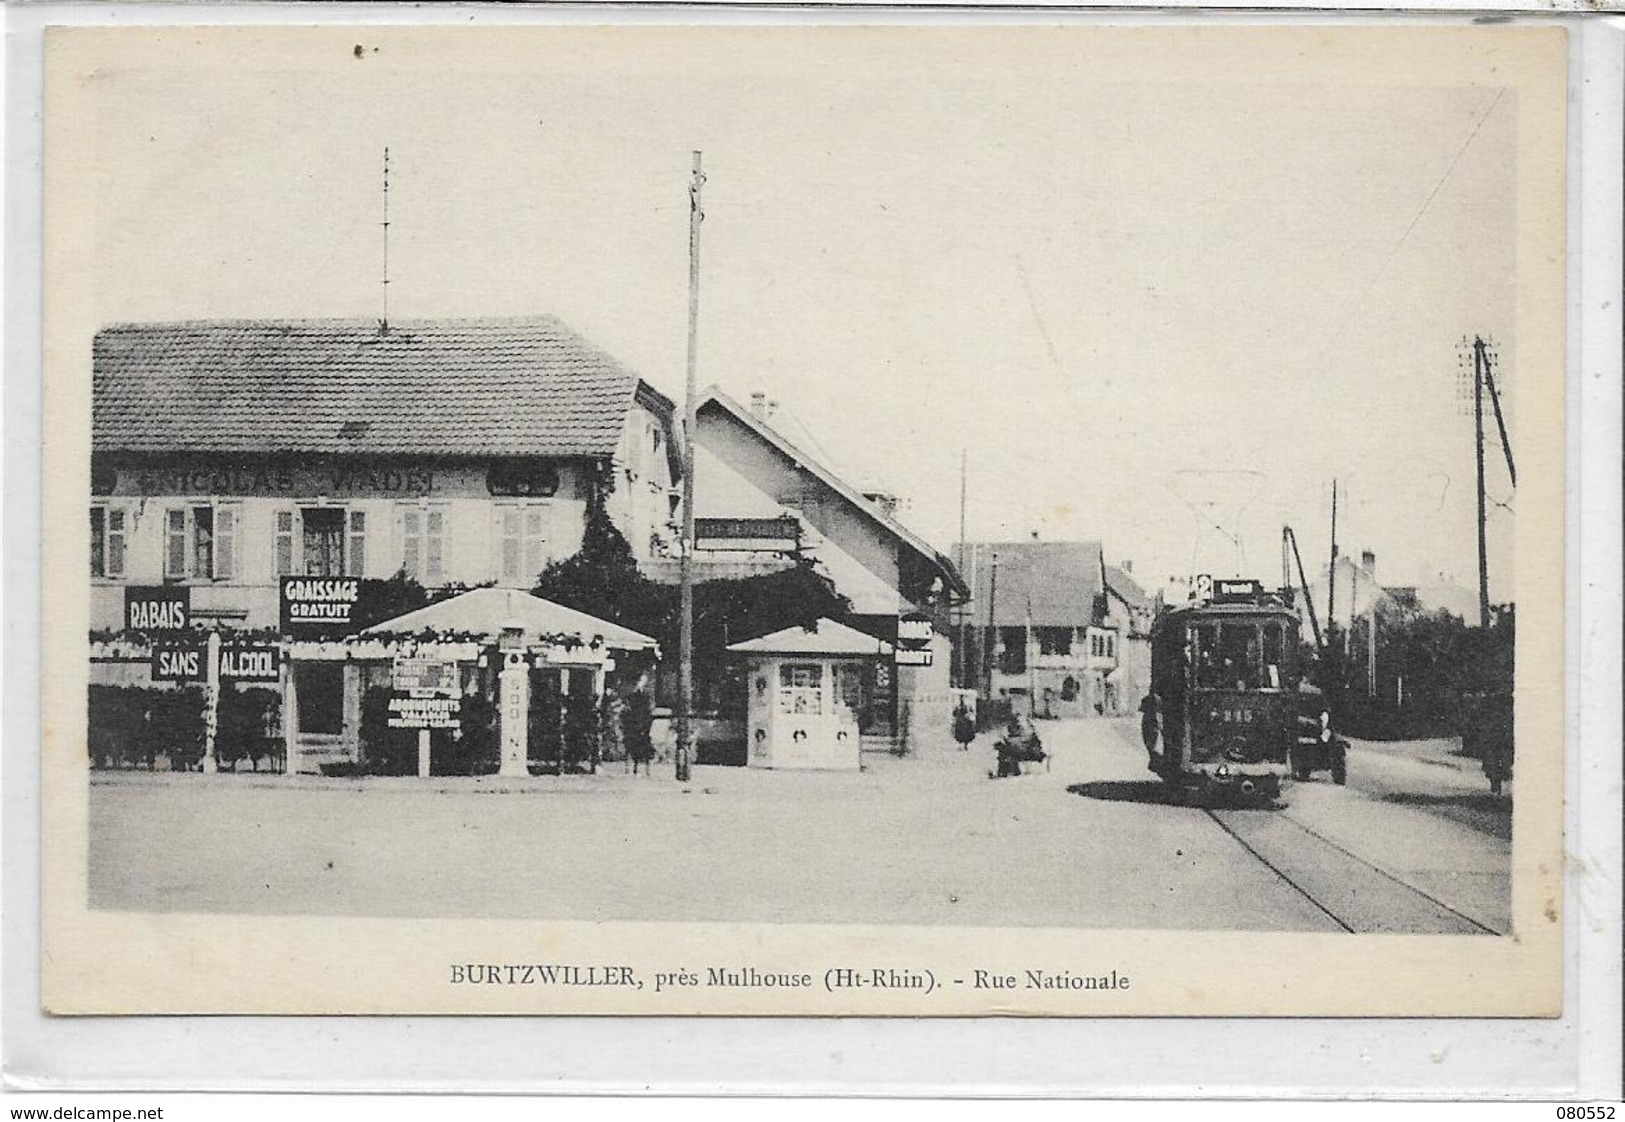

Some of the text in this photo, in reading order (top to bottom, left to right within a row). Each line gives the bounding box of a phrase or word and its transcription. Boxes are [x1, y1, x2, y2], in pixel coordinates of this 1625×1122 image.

[286, 580, 358, 602] GRAISSAGE
[130, 601, 185, 630] RABAIS
[290, 603, 352, 618] GRATUIT
[159, 651, 199, 675] SANS
[219, 651, 279, 677] ALCOOL
[449, 964, 643, 990] BURTZWILLER,
[655, 967, 699, 992] près
[706, 967, 811, 987] Mulhouse
[824, 968, 941, 994] (Ht-Rhin).
[974, 969, 1016, 989] Rue
[1025, 970, 1130, 990] Nationale
